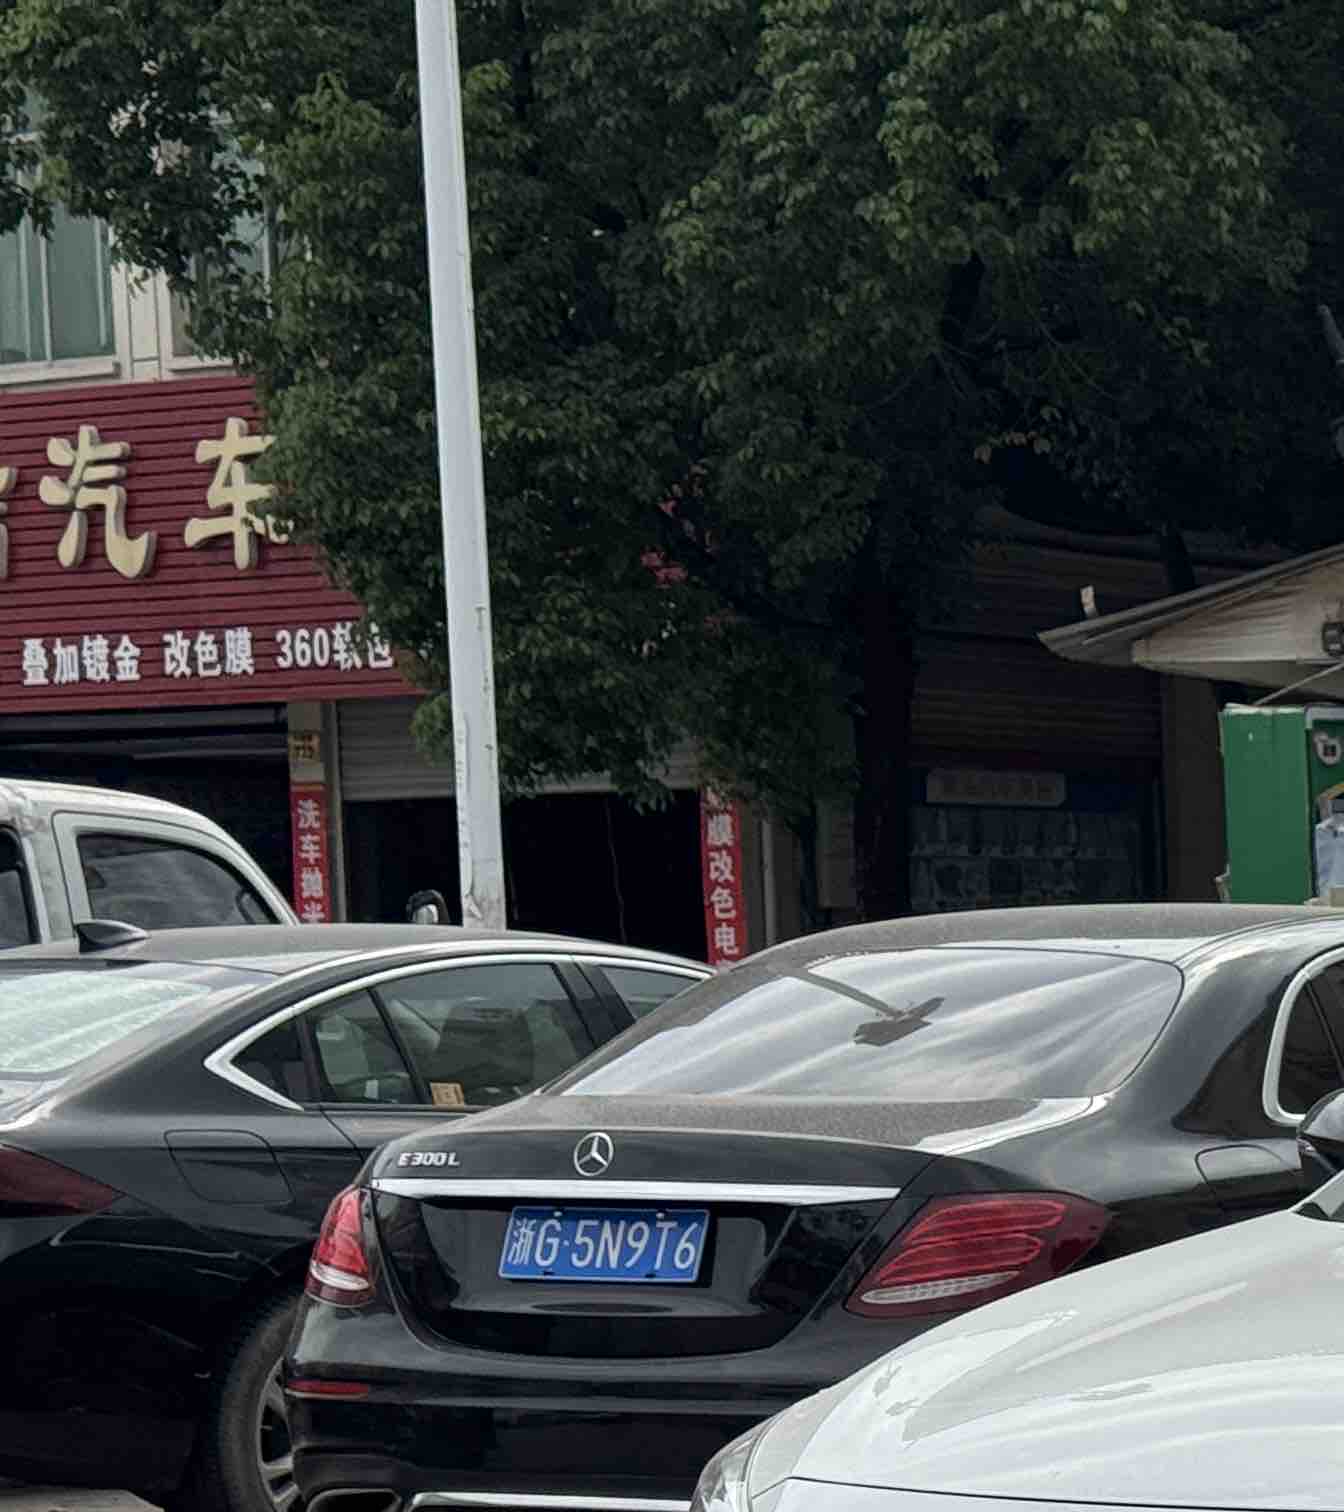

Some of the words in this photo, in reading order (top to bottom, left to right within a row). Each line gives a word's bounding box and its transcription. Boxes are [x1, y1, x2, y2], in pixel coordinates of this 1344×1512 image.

[0, 417, 294, 578] 汽车
[22, 634, 141, 686] 叠加镀金
[163, 627, 255, 678] 改色膜
[704, 786, 741, 968] 膜改色电
